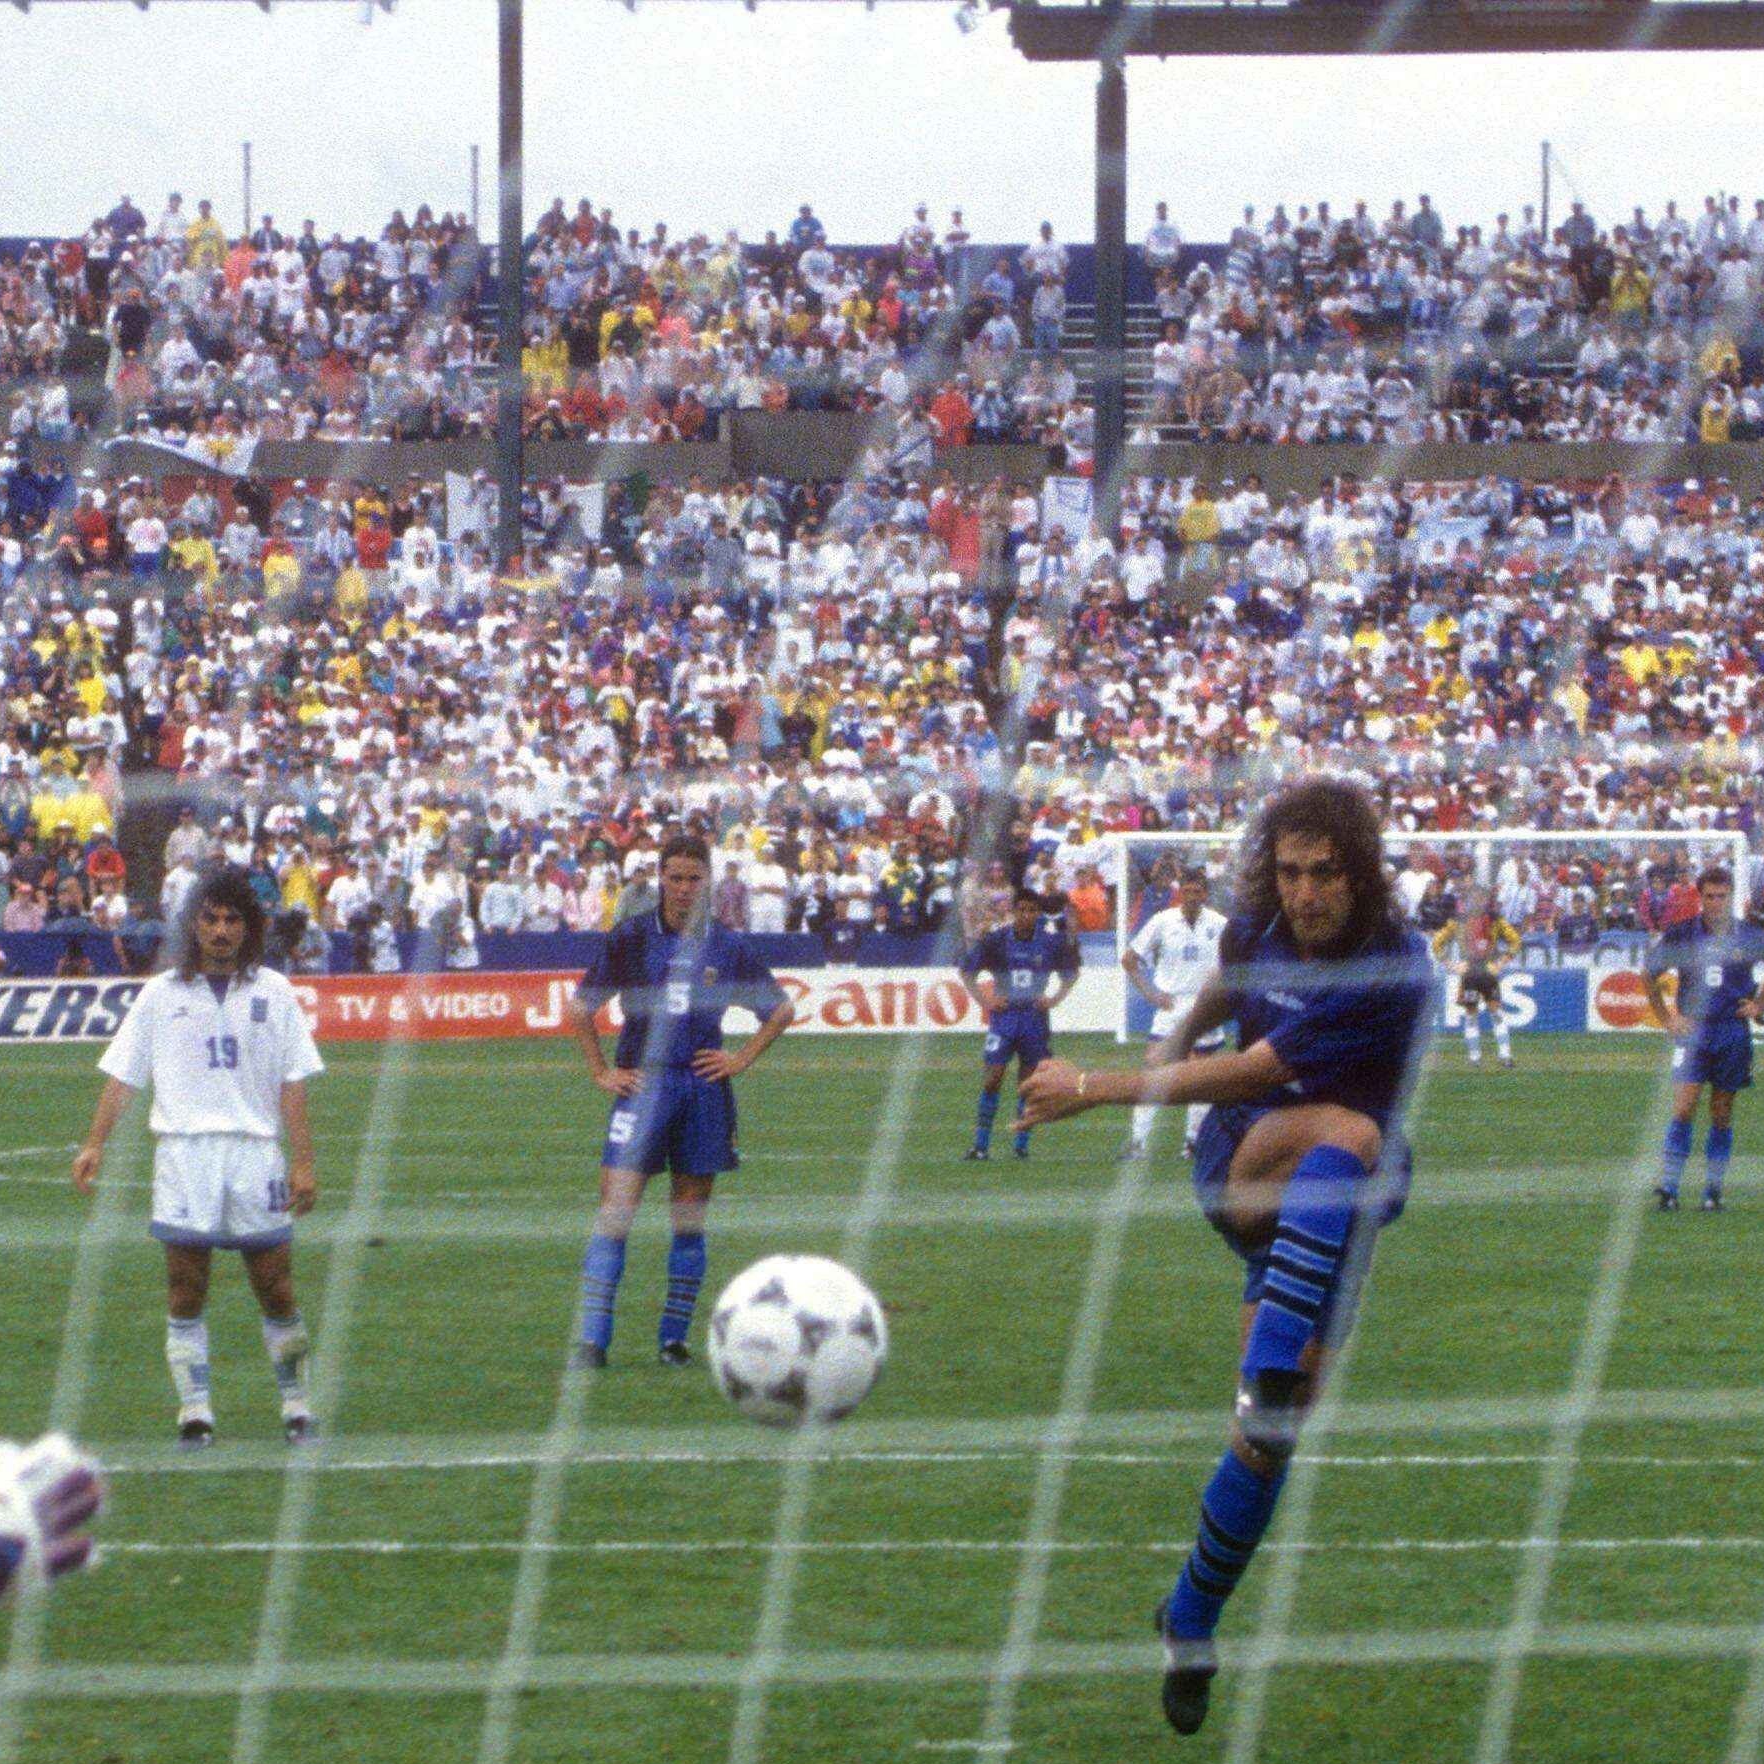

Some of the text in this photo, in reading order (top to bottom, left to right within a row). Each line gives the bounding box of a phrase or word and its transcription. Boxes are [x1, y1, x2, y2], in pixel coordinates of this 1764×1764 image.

[337, 996, 377, 1020] TV
[421, 993, 511, 1019] VIDEO
[774, 976, 989, 1028] Cano
[206, 1034, 238, 1070] 19
